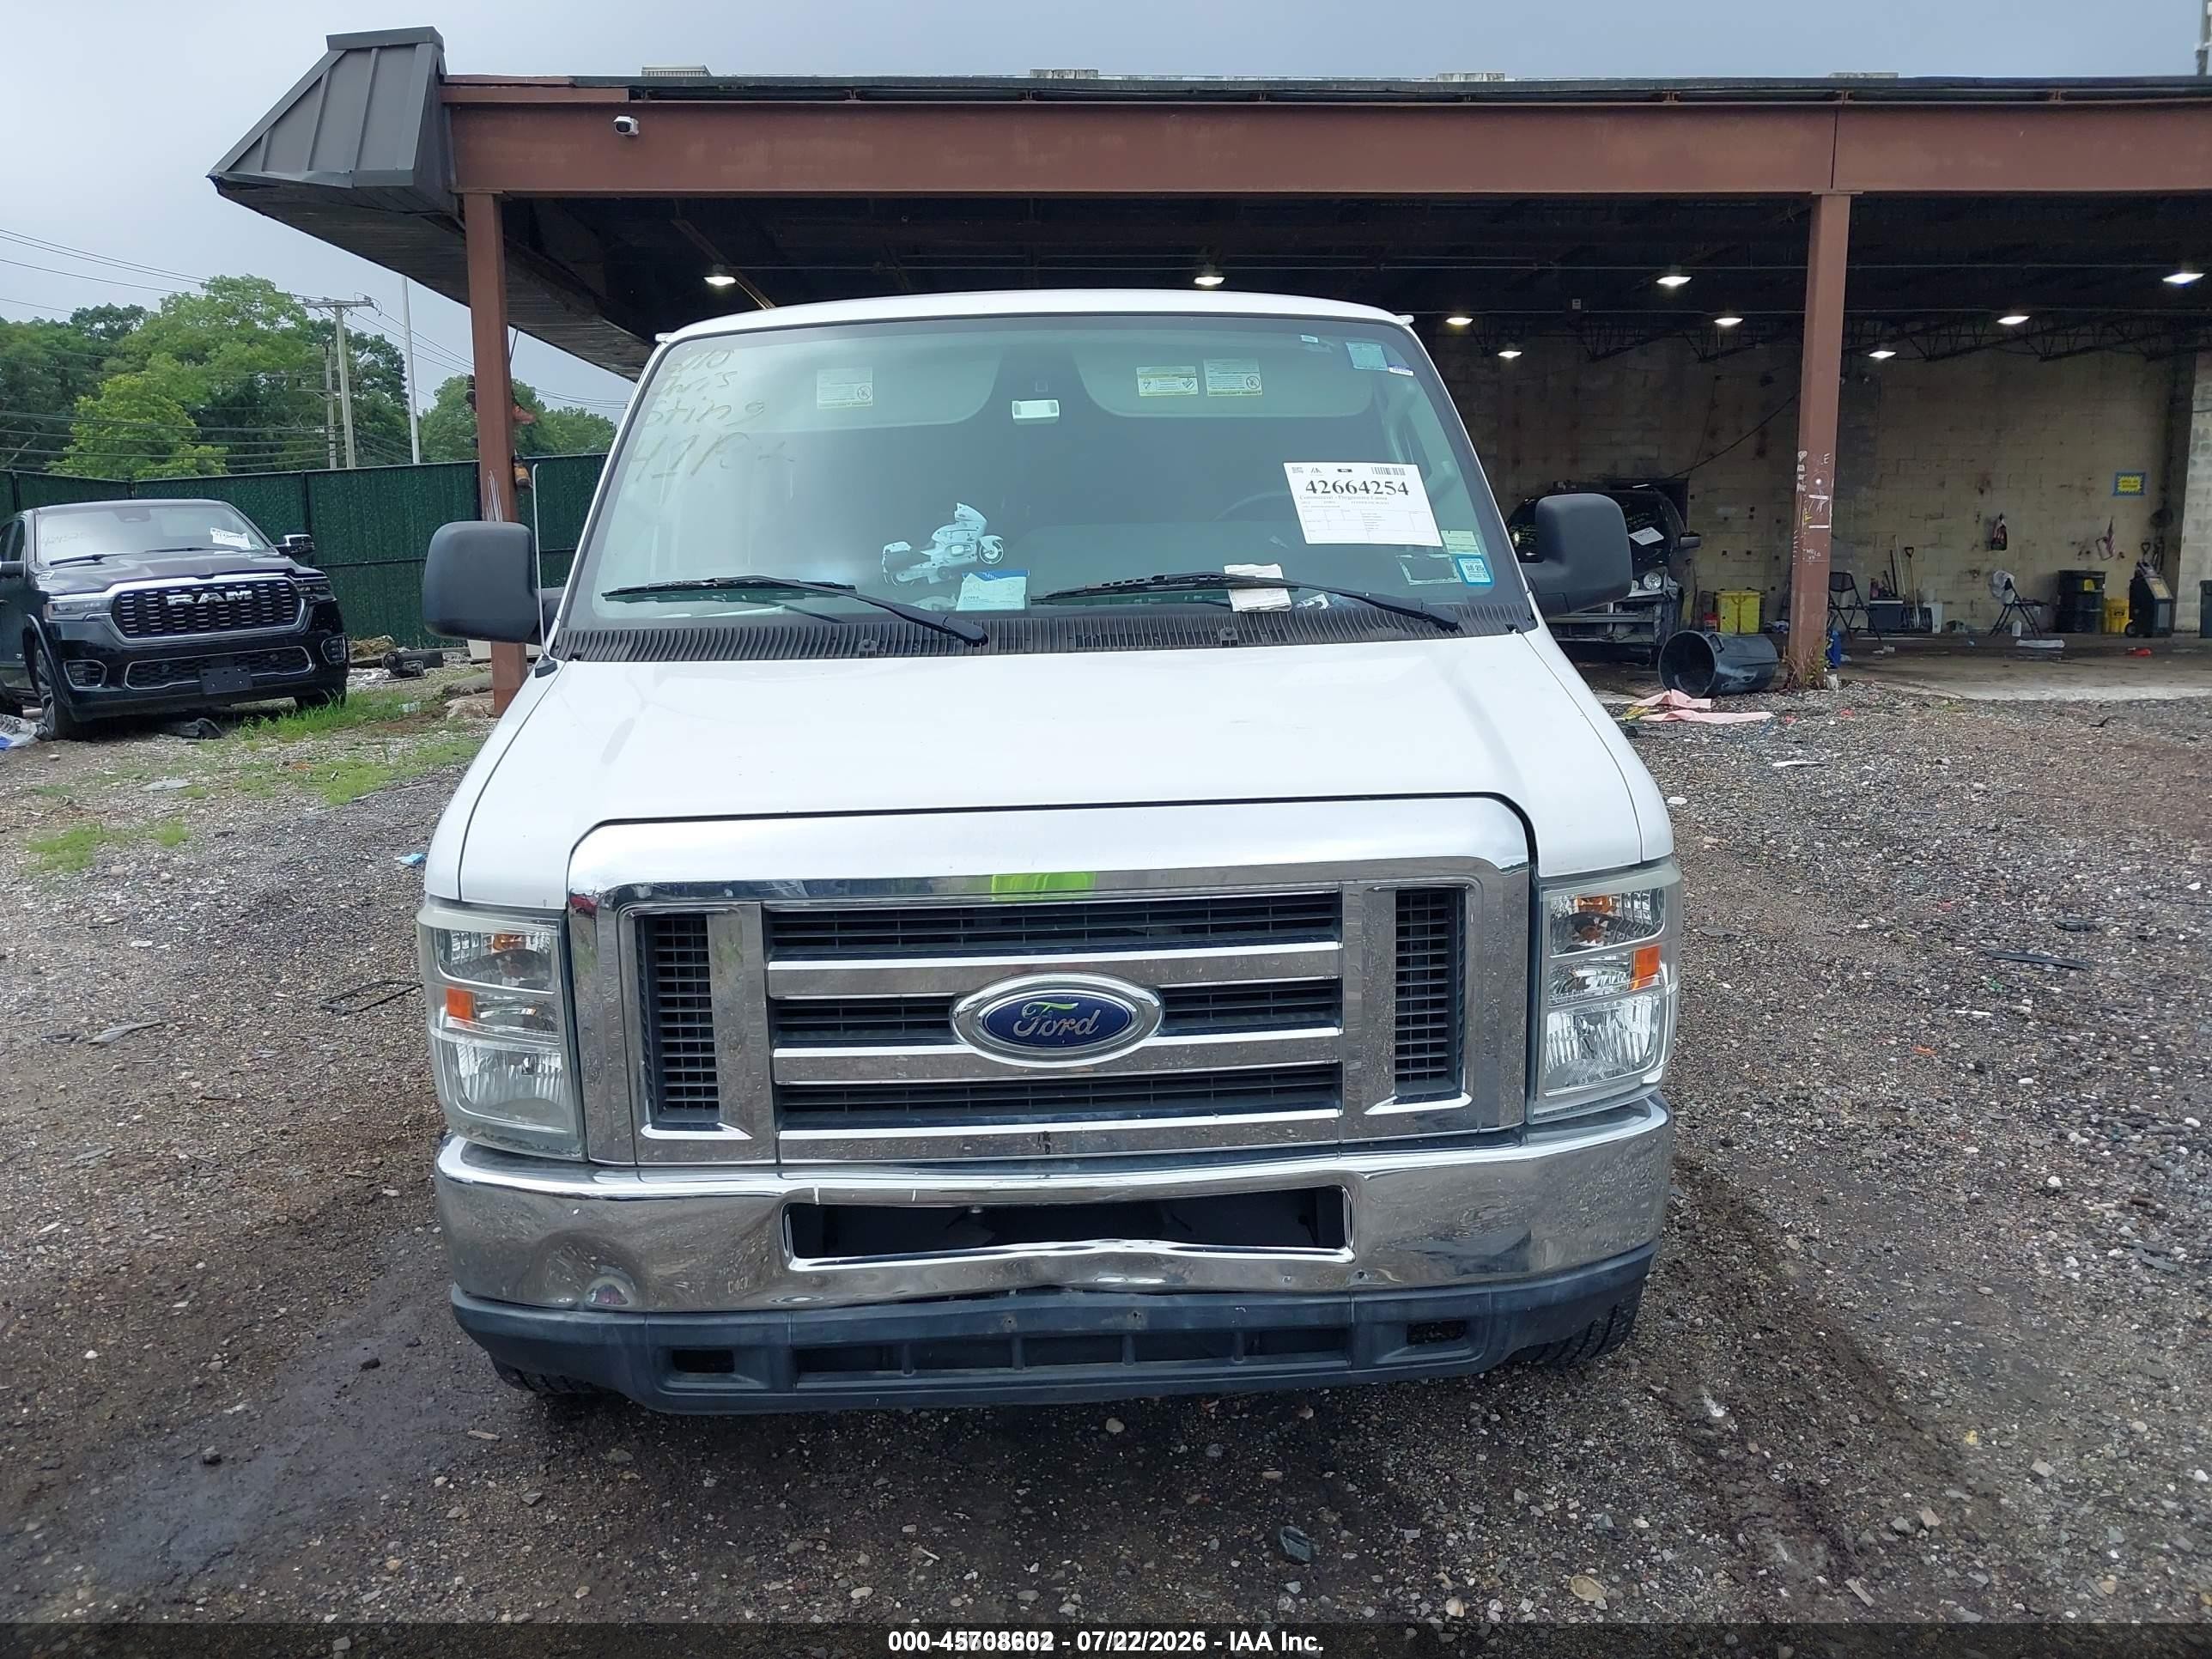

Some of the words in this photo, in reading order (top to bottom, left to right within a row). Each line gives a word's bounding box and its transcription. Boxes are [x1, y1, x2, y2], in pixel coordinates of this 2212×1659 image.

[1305, 480, 1410, 496] 42664254
[166, 590, 253, 606] RAM
[1013, 1001, 1102, 1036] Ford
